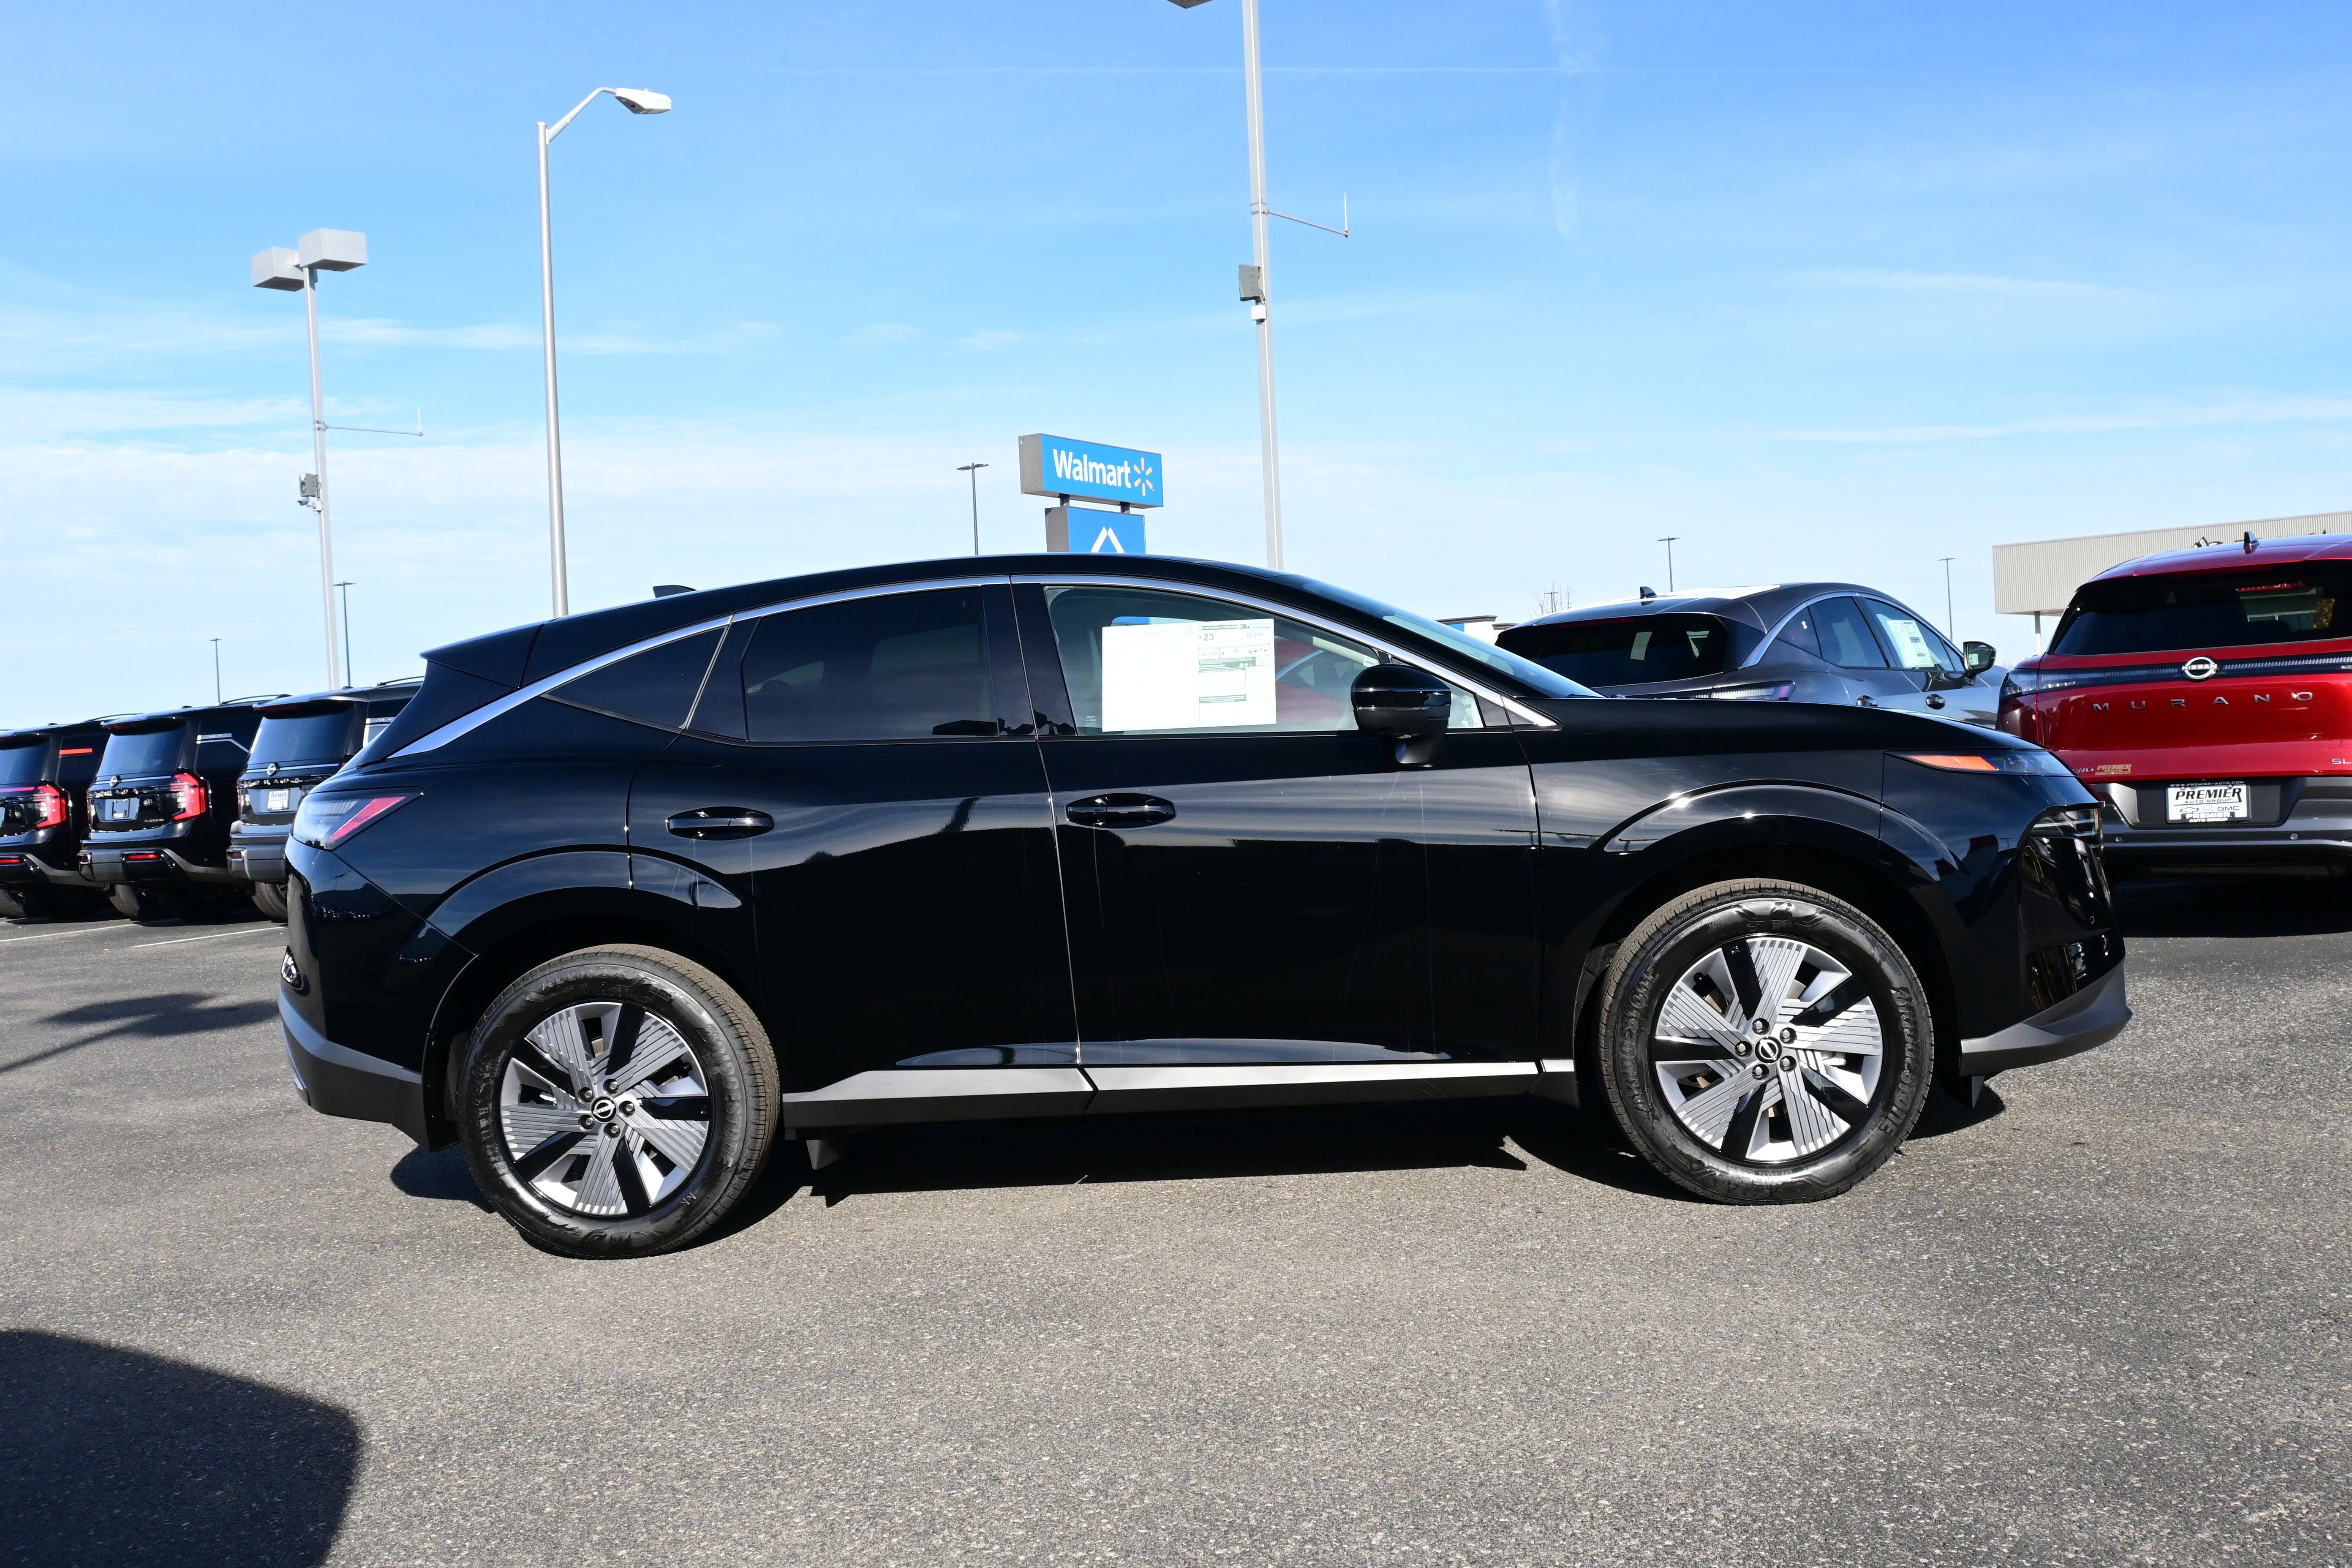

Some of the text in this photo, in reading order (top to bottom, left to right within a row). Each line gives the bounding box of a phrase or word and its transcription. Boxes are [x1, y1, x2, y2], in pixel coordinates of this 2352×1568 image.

[1052, 448, 1132, 488] Walmart
[1203, 633, 1214, 641] 23
[2093, 691, 2313, 711] MURANO
[2096, 764, 2132, 774] PREMIER
[2175, 787, 2242, 803] PREMIER
